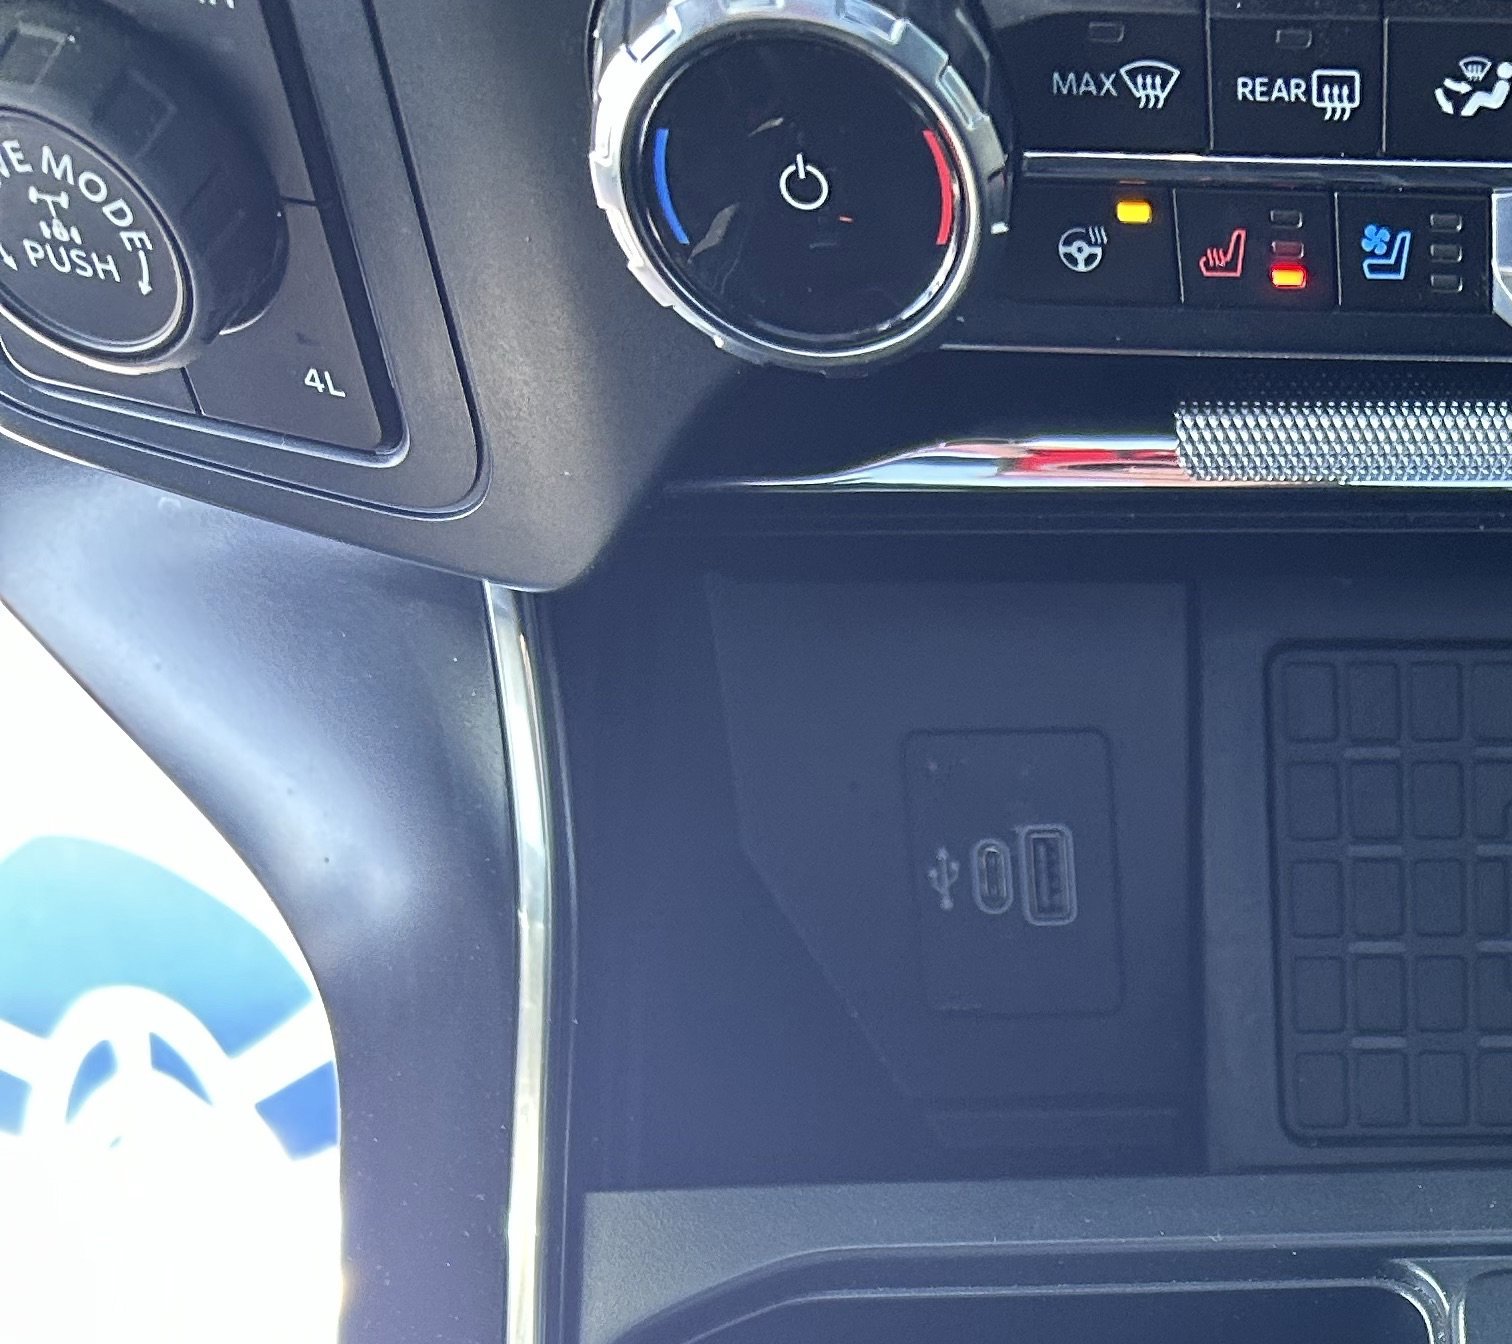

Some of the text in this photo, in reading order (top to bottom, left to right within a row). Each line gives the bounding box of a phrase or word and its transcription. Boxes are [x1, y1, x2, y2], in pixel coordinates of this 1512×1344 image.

[1052, 71, 1118, 97] MAX
[1236, 77, 1307, 103] REAR
[41, 145, 153, 252] MODE
[23, 238, 121, 283] PUSH
[304, 367, 346, 398] 4L
